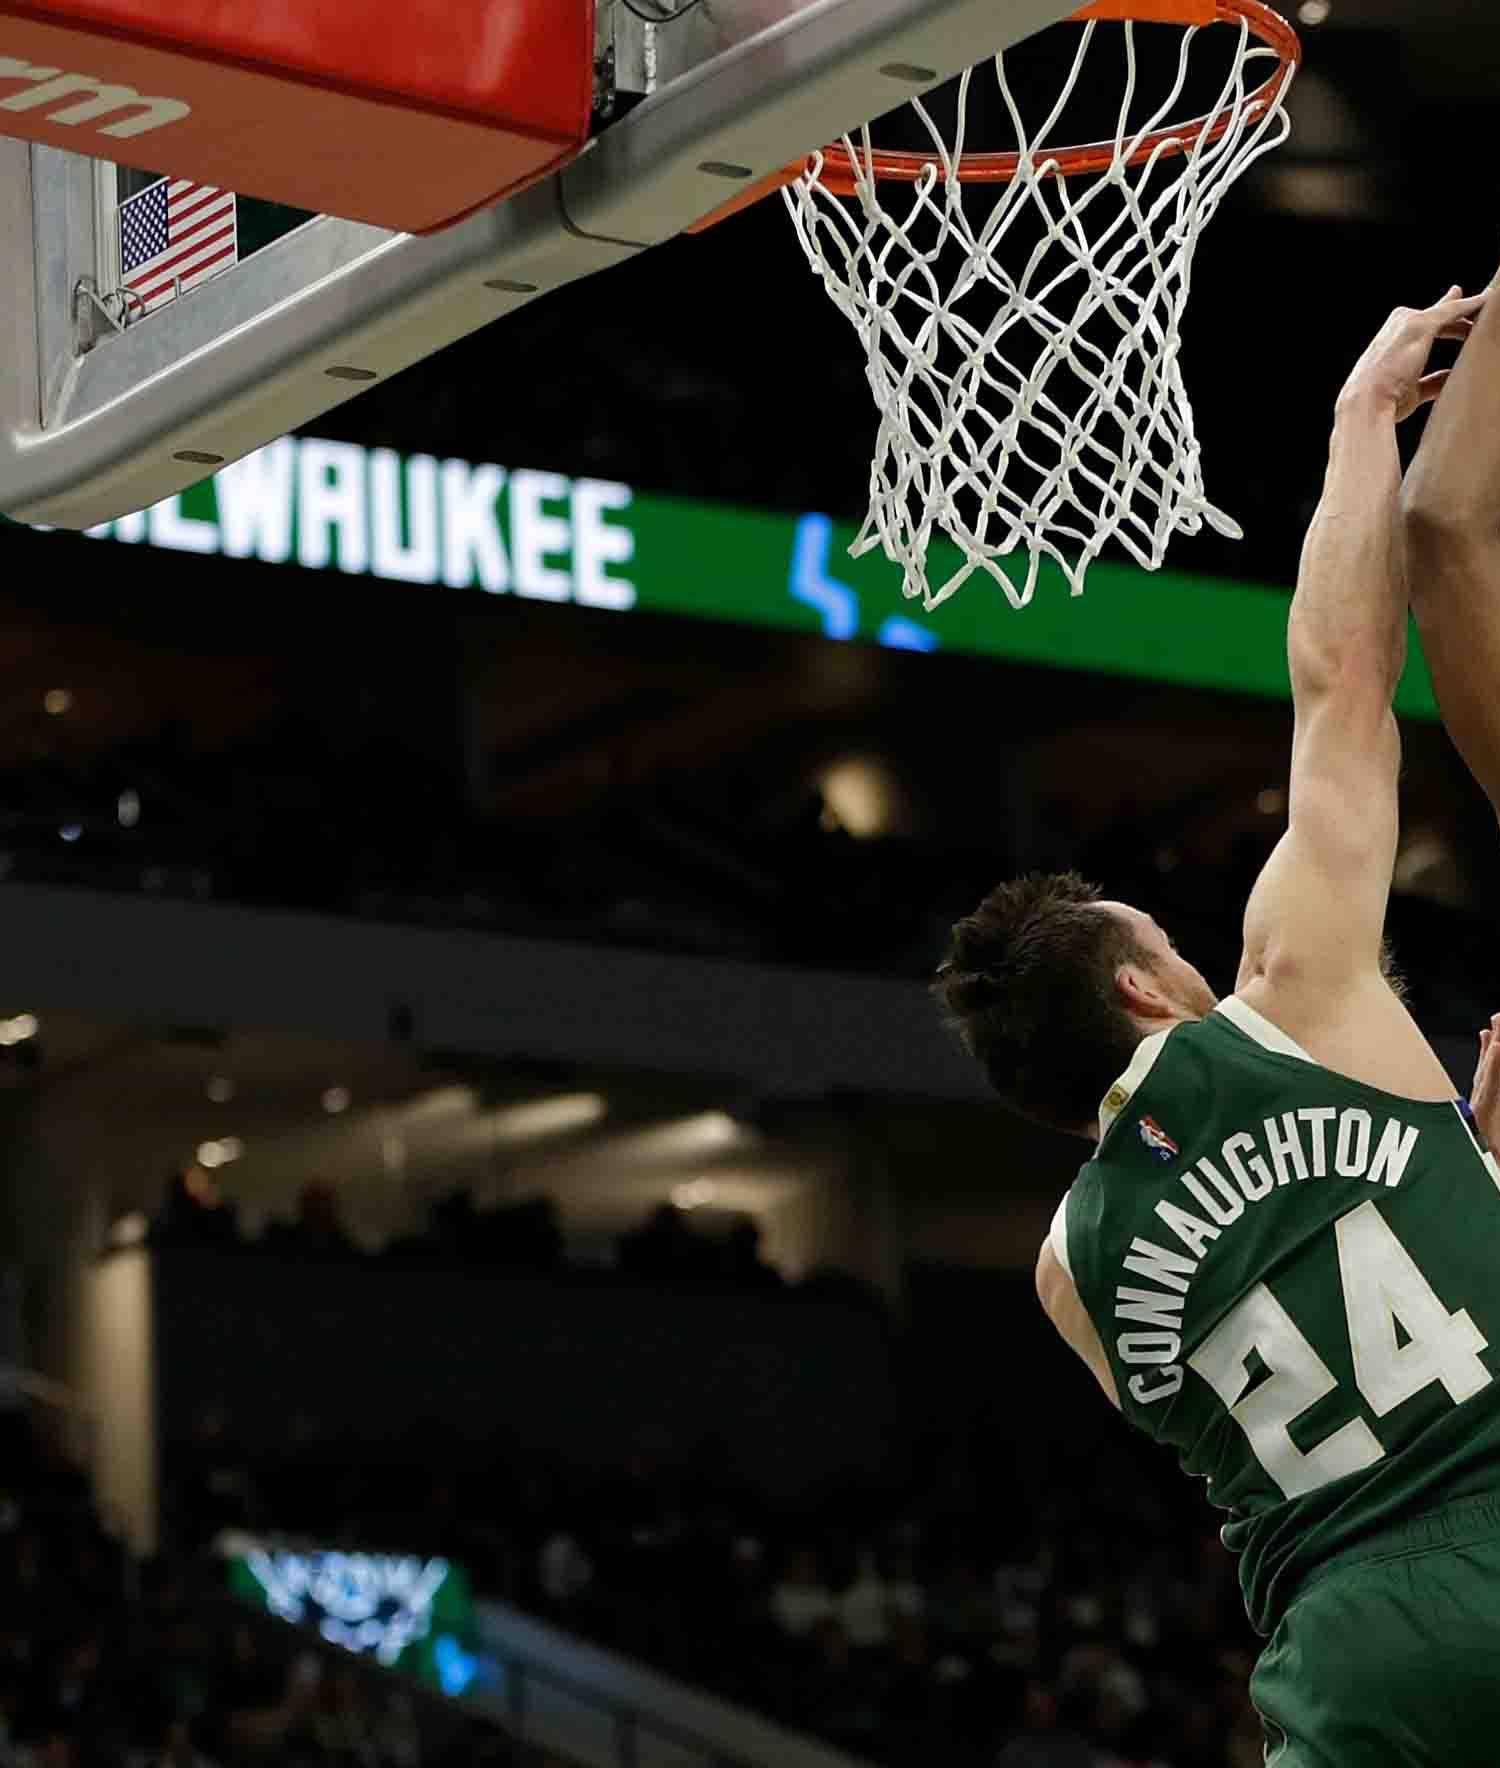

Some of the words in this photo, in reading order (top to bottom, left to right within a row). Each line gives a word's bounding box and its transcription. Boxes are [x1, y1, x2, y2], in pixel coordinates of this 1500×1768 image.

[32, 434, 636, 611] LWAUKEE
[1115, 1107, 1420, 1404] CONNAUGHTON
[1187, 1200, 1493, 1500] 24
